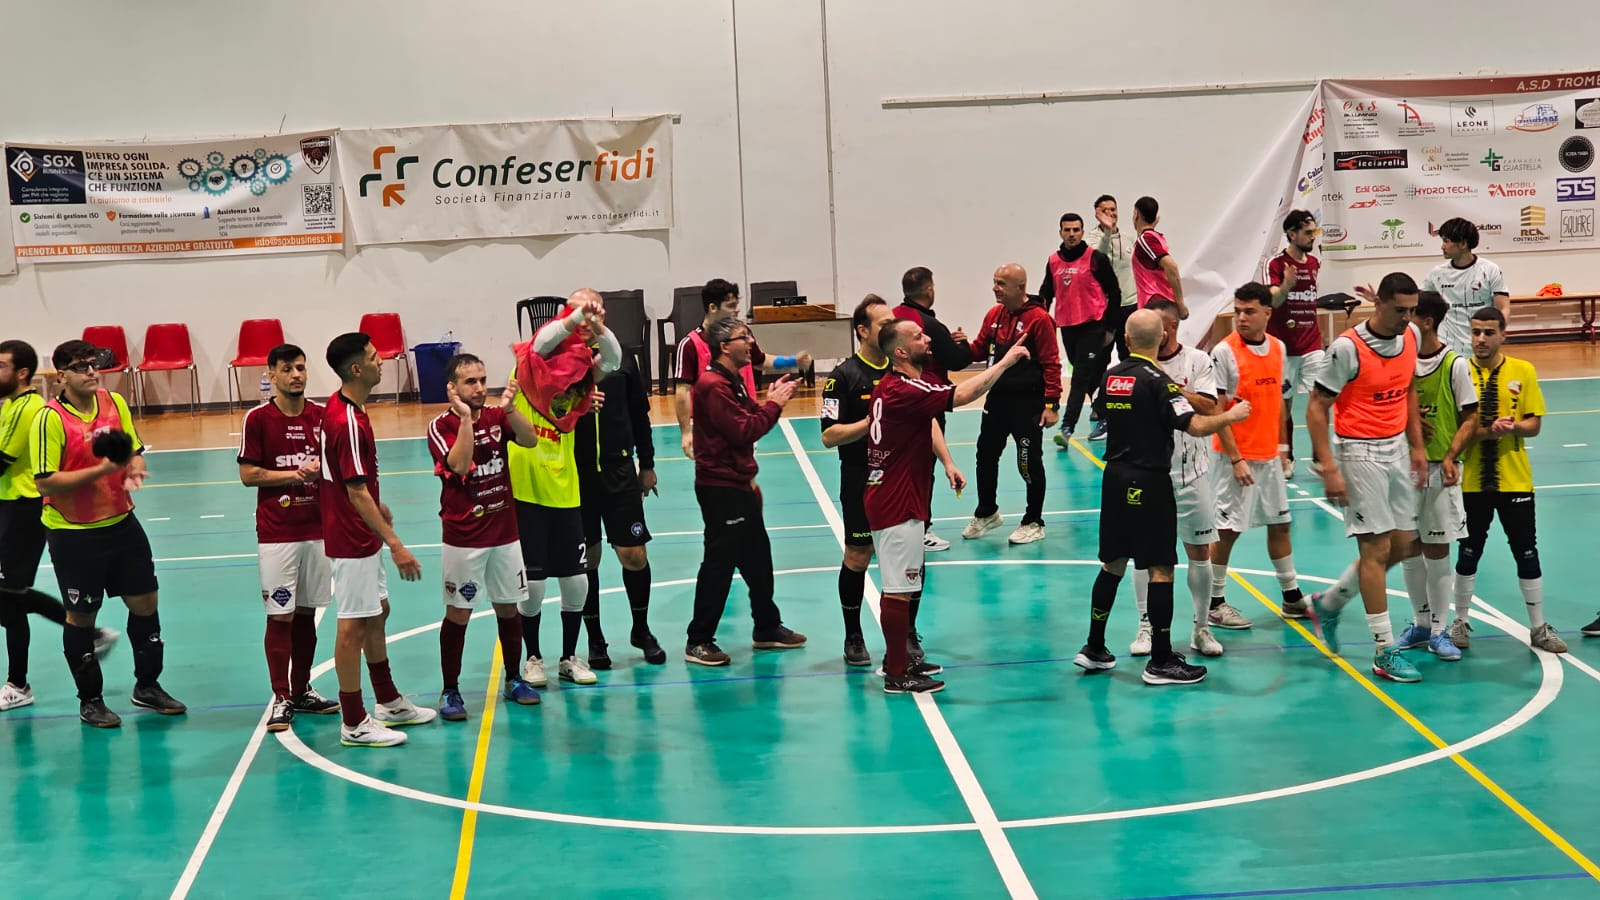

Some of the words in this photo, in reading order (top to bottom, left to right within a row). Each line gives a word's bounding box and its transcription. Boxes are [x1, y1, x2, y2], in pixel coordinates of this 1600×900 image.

[1516, 79, 1551, 91] A.S.D
[1457, 120, 1489, 128] LEONE
[1421, 144, 1442, 154] Gold
[43, 154, 75, 168] SGX
[85, 152, 120, 161] DIETRO
[123, 152, 149, 161] OGNI
[87, 161, 128, 171] IMPRESA
[131, 161, 170, 171] SOLIDA,
[433, 147, 655, 189] Confeserfidi
[1421, 163, 1442, 171] Cash
[1503, 163, 1542, 171] GUASTELLA
[105, 172, 121, 181] UN
[123, 171, 165, 180] SISTEMA
[88, 183, 109, 192] CHE
[110, 182, 162, 192] FUNZIONA
[1355, 185, 1370, 193] Edil
[1414, 186, 1445, 196] HYDRO
[1446, 185, 1470, 194] TECH
[1557, 178, 1594, 197] STS
[435, 192, 487, 206] Società
[494, 188, 572, 203] Finanziaria
[248, 206, 261, 214] SOA
[566, 209, 660, 222] www.confeserfidi.it
[1562, 214, 1592, 237] SQUARE
[1520, 228, 1545, 236] RCA
[255, 234, 333, 246] info@sgxbusiness.it
[17, 247, 55, 256] PRENOTA
[58, 247, 69, 255] LA
[71, 246, 88, 255] TUA
[90, 244, 143, 254] CONSULENZA
[145, 242, 190, 252] AZIENDALE
[192, 240, 235, 250] GRATUITA
[1106, 378, 1134, 391] Lete
[870, 397, 883, 445] 8
